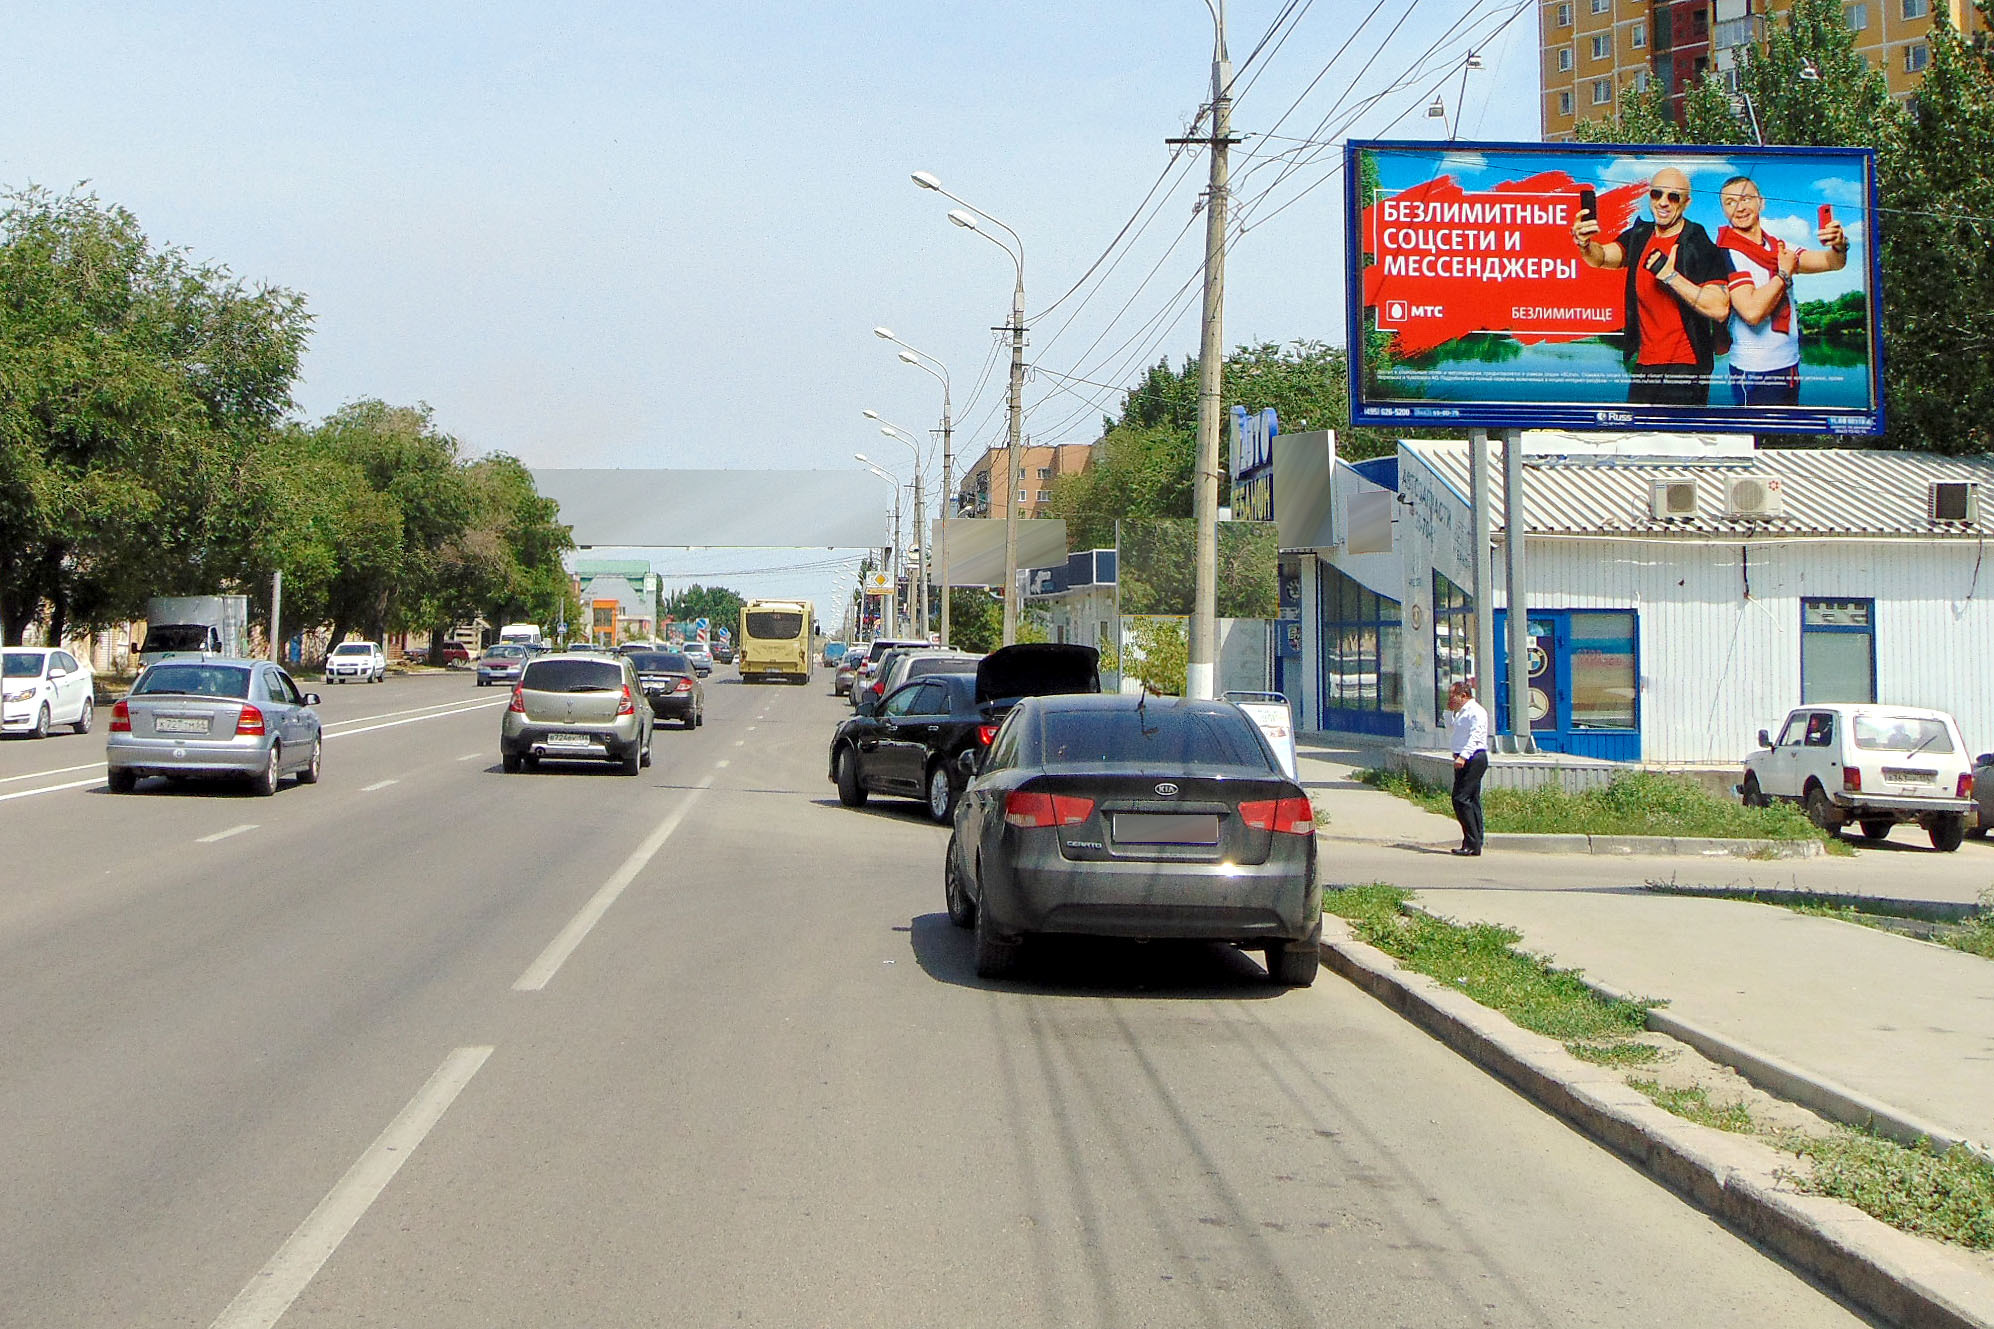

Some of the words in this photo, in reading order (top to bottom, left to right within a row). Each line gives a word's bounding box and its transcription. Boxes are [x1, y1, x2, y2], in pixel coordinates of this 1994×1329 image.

[1384, 201, 1568, 225] БЕЗЛИМИТНЫЕ
[1383, 228, 1496, 253] СОЦСЕТИ
[1504, 231, 1521, 251] И
[1384, 255, 1577, 282] МЕССЕНДЖЕРЫ
[1511, 306, 1613, 321] БЕЗЛИМИТИЩЕ
[1608, 412, 1633, 421] Russ
[1159, 785, 1175, 794] KIA
[1066, 840, 1102, 849] CERATO
